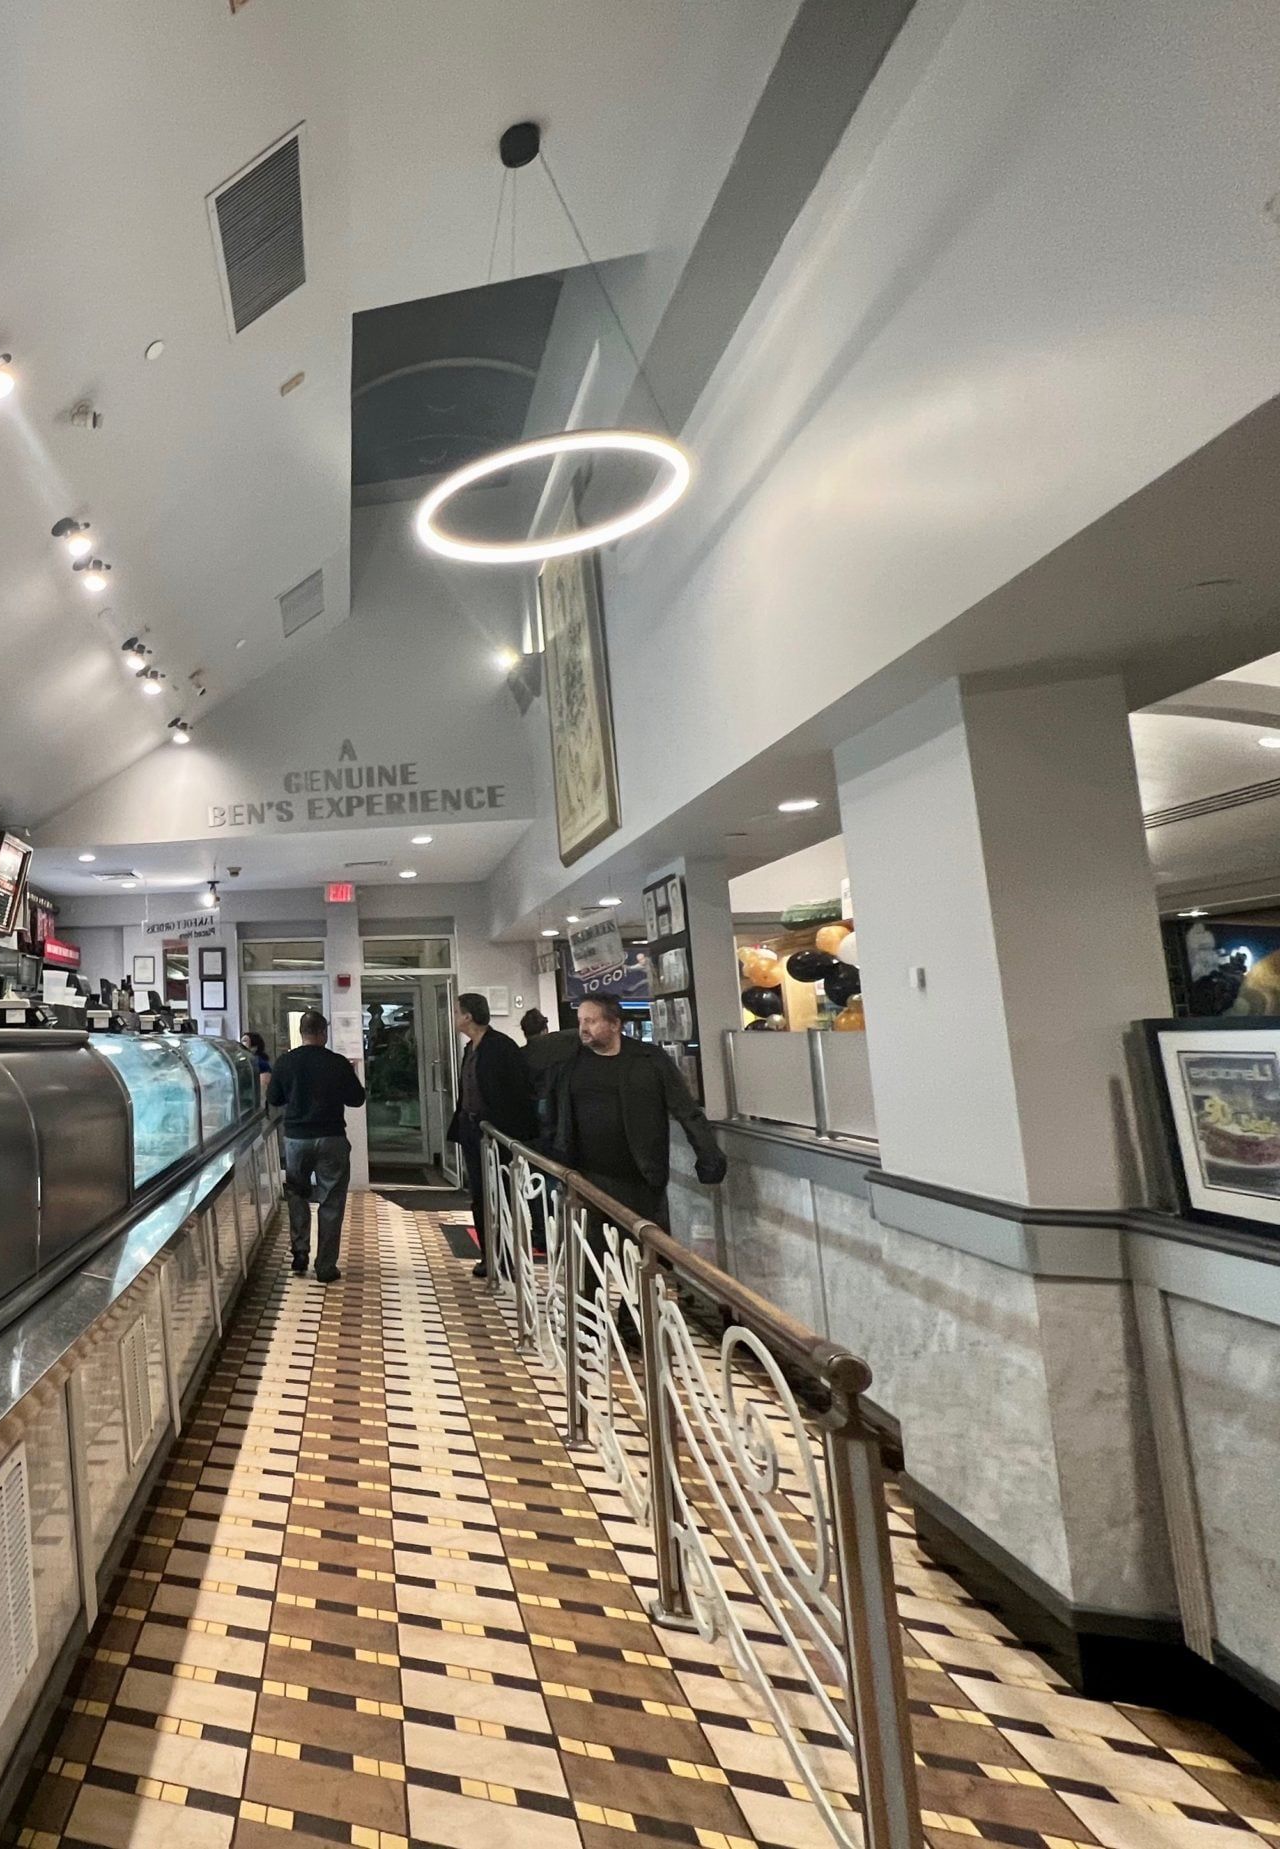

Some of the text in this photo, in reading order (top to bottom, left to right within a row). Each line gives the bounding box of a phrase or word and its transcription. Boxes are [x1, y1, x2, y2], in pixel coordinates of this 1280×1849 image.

[338, 738, 357, 762] A
[283, 762, 418, 794] GENUINE
[207, 785, 506, 828] BEN'S EXPERIENCE
[331, 884, 352, 902] EXIT
[582, 967, 628, 994] TO GO!
